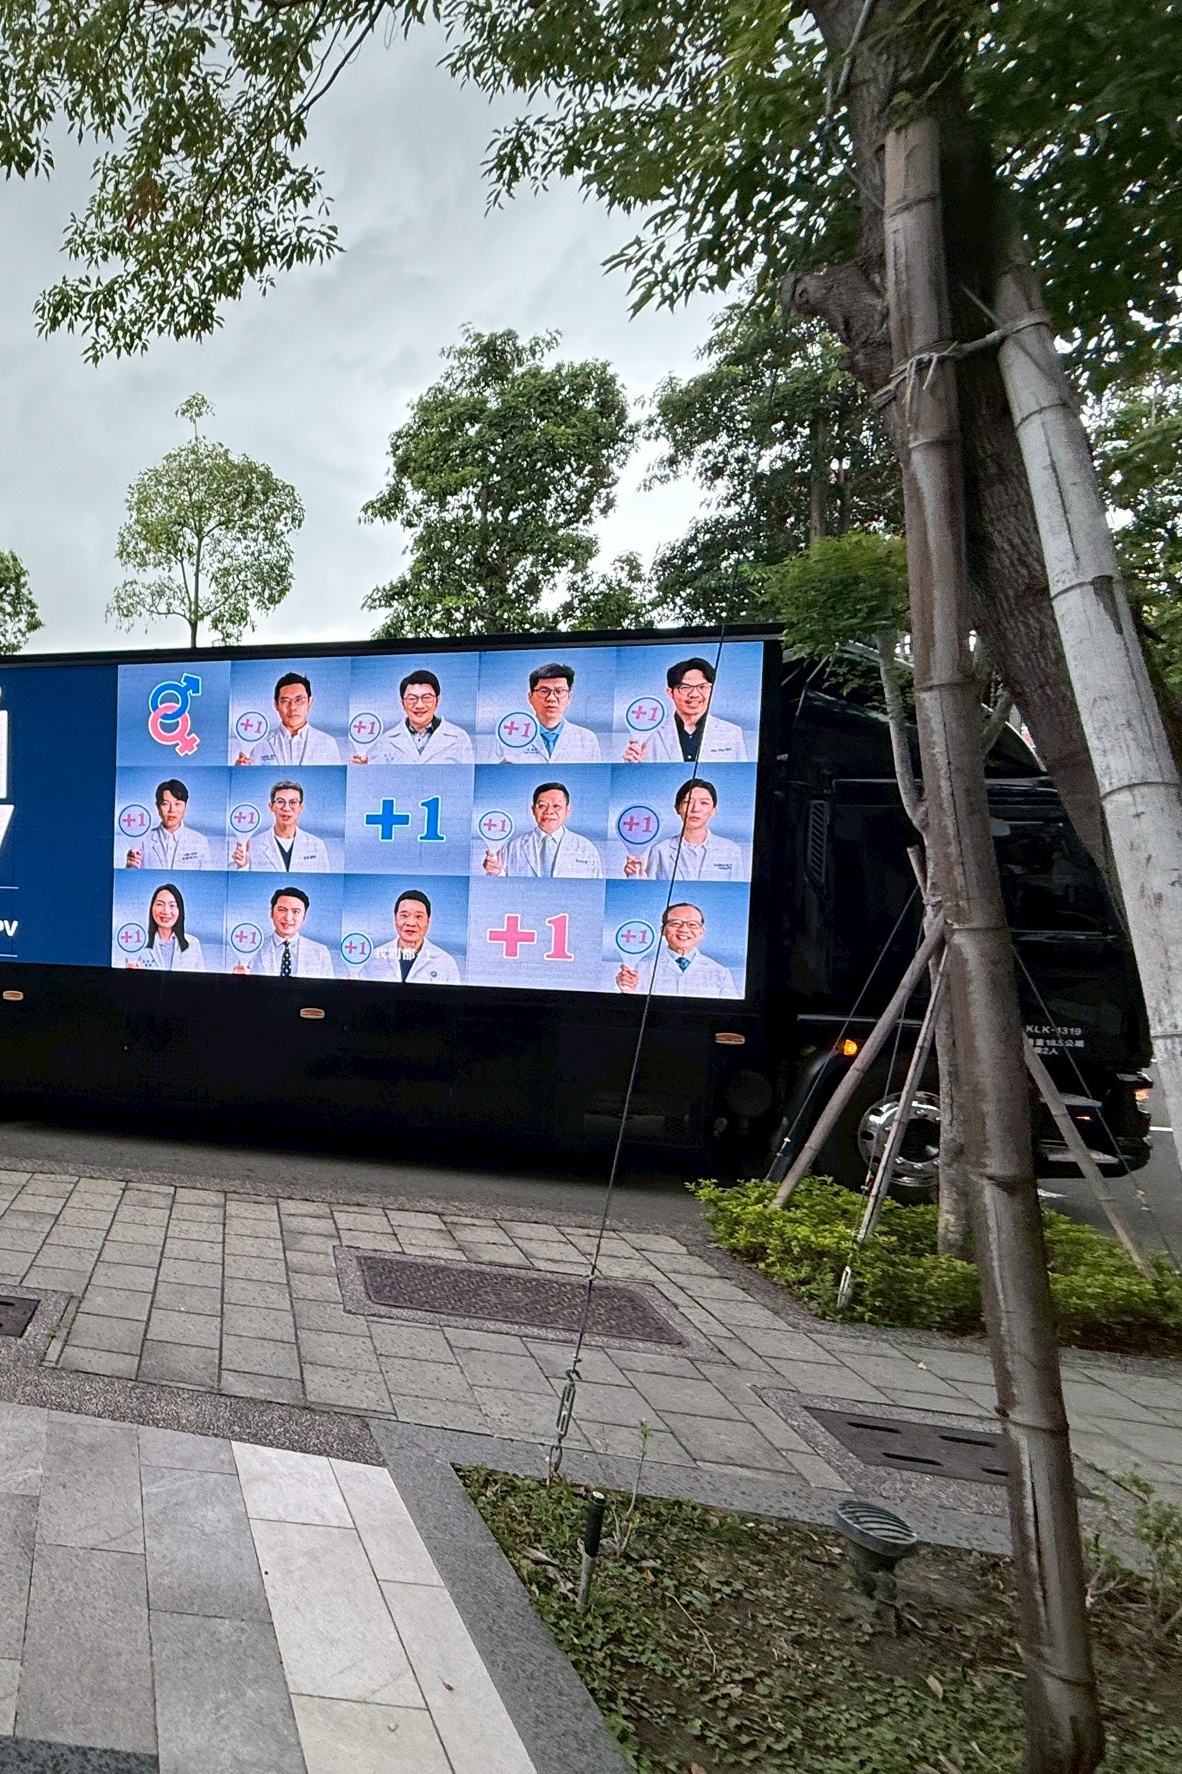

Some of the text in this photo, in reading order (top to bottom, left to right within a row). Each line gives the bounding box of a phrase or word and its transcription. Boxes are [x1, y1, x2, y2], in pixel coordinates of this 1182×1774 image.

[630, 705, 659, 722] +1
[240, 718, 263, 734] +1
[353, 720, 378, 735] +1
[503, 720, 532, 738] +1
[122, 813, 146, 827] +1
[233, 811, 256, 824] +1
[364, 796, 446, 843] +1
[483, 818, 508, 832] +1
[622, 815, 653, 834] +1
[121, 930, 142, 943] +1
[234, 930, 258, 945] +1
[487, 913, 574, 961] +1
[620, 929, 648, 945] +1
[1026, 1024, 1082, 1036] KLK-1319
